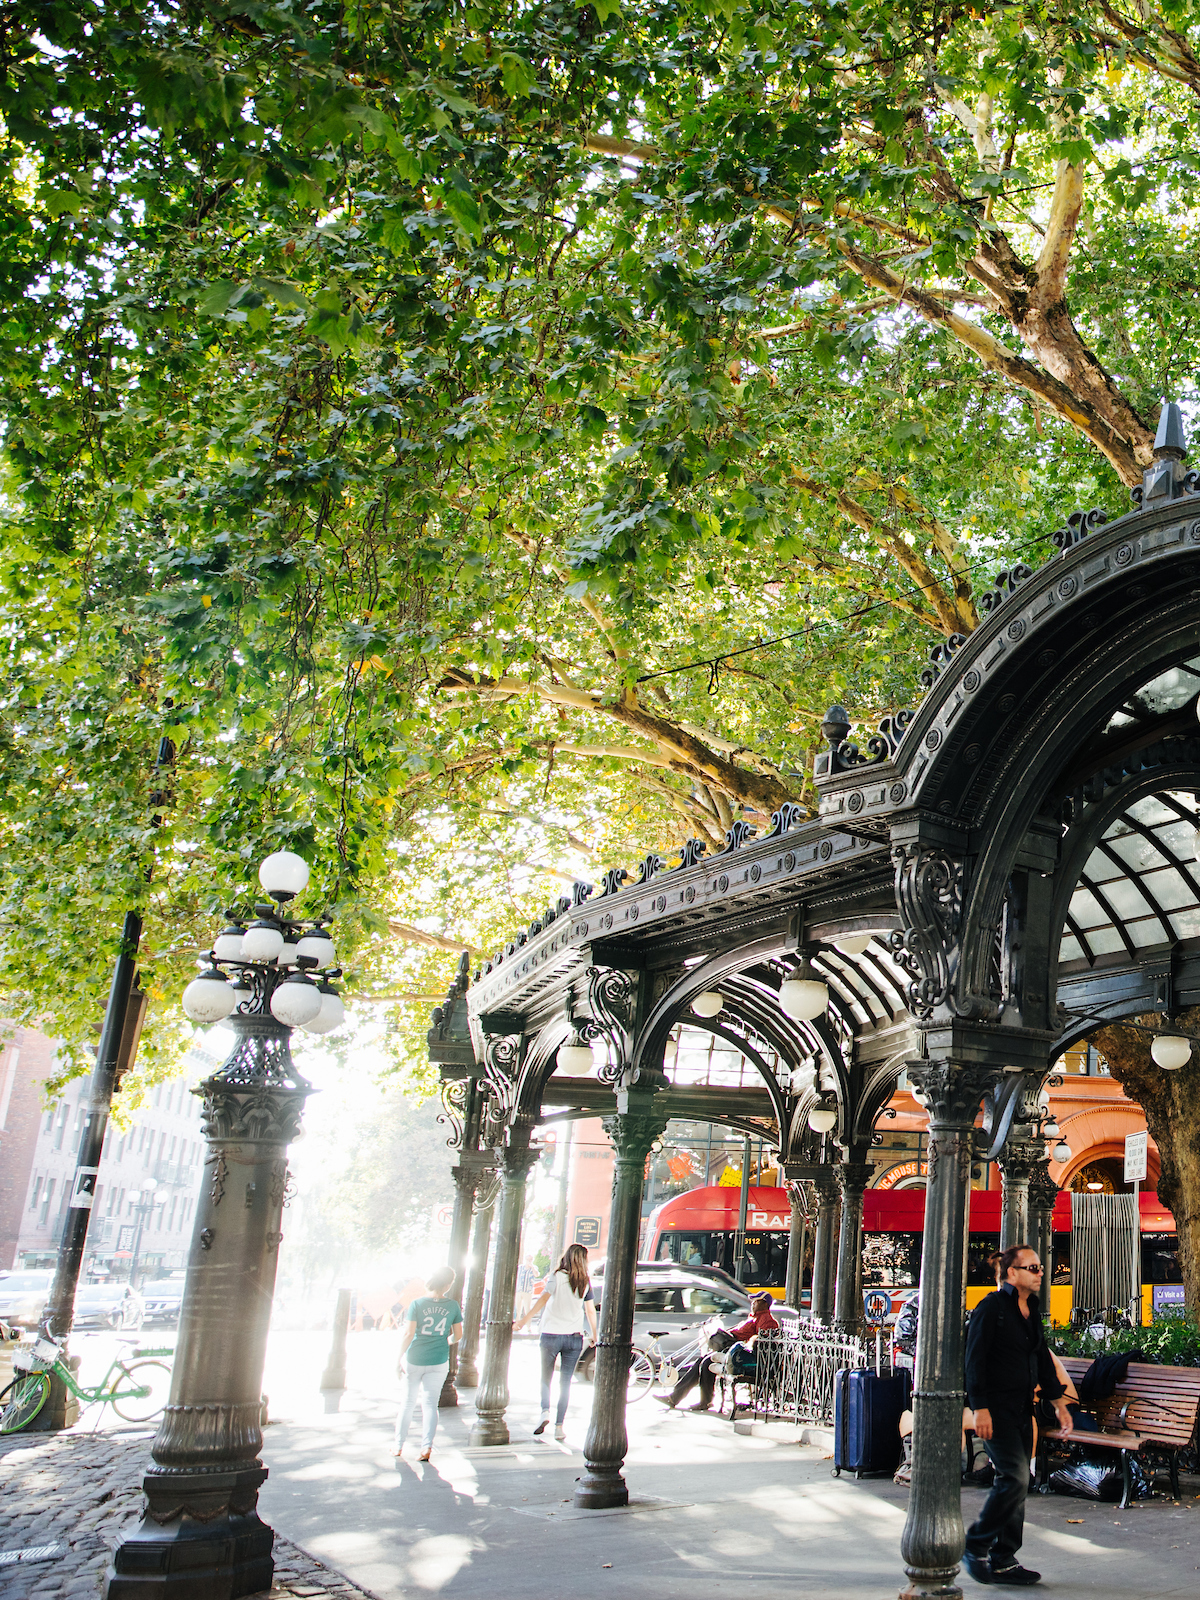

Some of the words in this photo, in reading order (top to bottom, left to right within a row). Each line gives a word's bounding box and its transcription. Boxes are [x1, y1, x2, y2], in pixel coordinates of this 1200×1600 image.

[886, 1162, 917, 1184] MOUSE
[422, 1306, 450, 1317] GRIFFEY
[420, 1316, 448, 1336] 24
